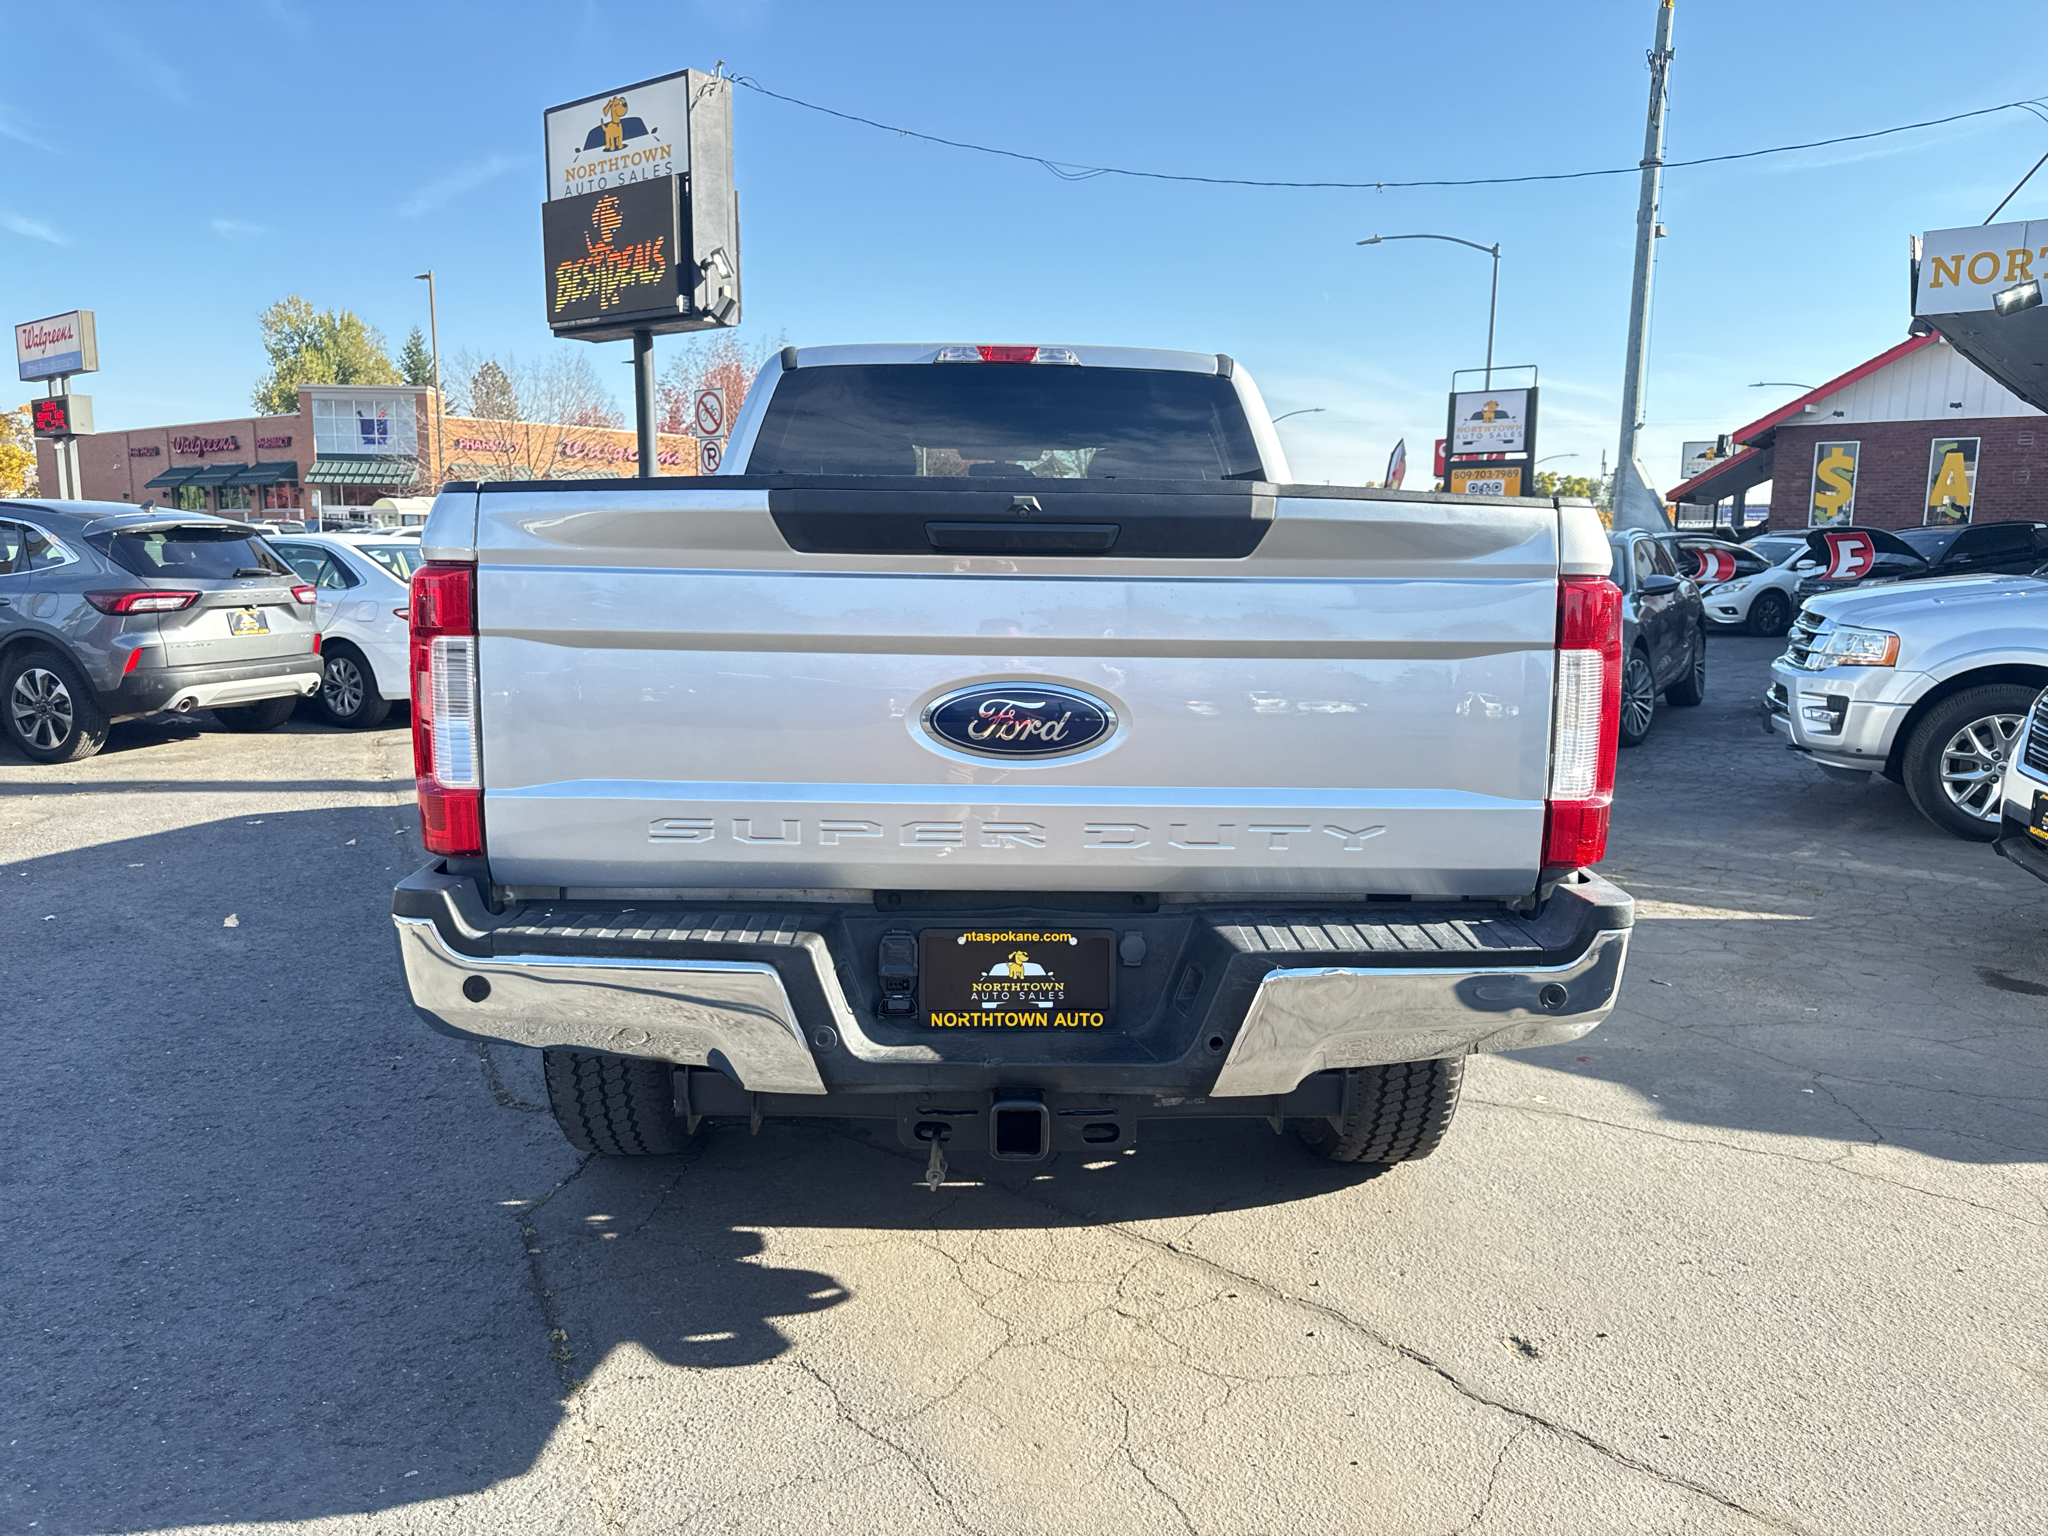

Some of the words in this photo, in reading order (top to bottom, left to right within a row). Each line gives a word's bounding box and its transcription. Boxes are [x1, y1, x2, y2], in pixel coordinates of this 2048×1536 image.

[564, 144, 673, 182] NORTHTOWN
[564, 177, 608, 198] AUTO
[618, 161, 673, 186] SALES
[22, 323, 74, 354] Walgreens
[1455, 432, 1483, 440] AUTO
[1488, 431, 1523, 439] SALES
[1456, 424, 1523, 434] NORTHTOWN
[170, 435, 237, 457] Walgreens
[563, 438, 684, 465] Walgrns
[707, 447, 717, 467] P
[1453, 469, 1519, 480] 509-703-7989
[1831, 541, 1865, 578] E
[967, 699, 1072, 741] Ford
[648, 818, 1046, 847] SUPER
[1084, 822, 1386, 851] DUTY
[963, 931, 1072, 944] ntaspokane.com
[971, 991, 1010, 1000] AUTO
[1019, 991, 1065, 1000] SALES
[972, 982, 1065, 991] NORTHTOWN
[931, 1012, 1048, 1027] NORTHTOWN
[1054, 1012, 1104, 1027] AUTO
